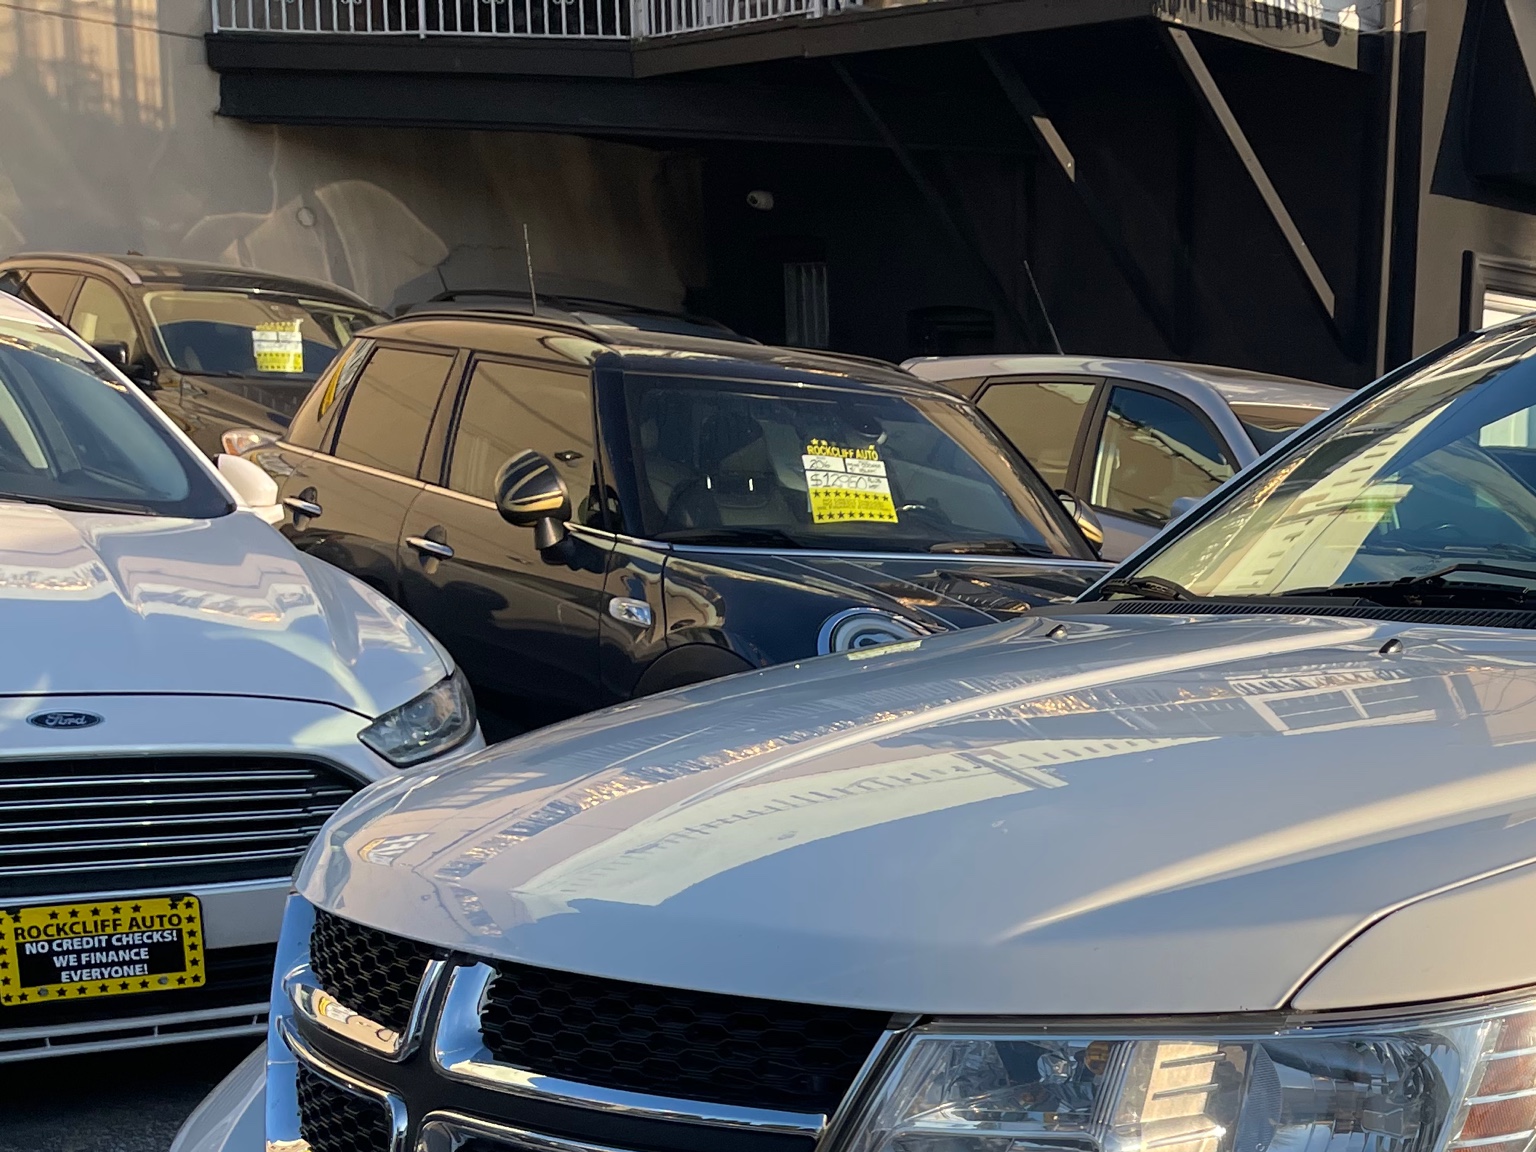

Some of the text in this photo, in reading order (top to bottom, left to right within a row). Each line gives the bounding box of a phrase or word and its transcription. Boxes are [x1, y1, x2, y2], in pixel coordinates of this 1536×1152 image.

[806, 444, 879, 461] ROCKCLIFF AUTO
[45, 714, 87, 726] Ford
[14, 914, 182, 940] ROCKCLIFF AUTO
[25, 930, 177, 955] NO CREDIT CHECKS!
[53, 948, 149, 968] WE FINANCE
[61, 964, 148, 983] EVERYONE!
